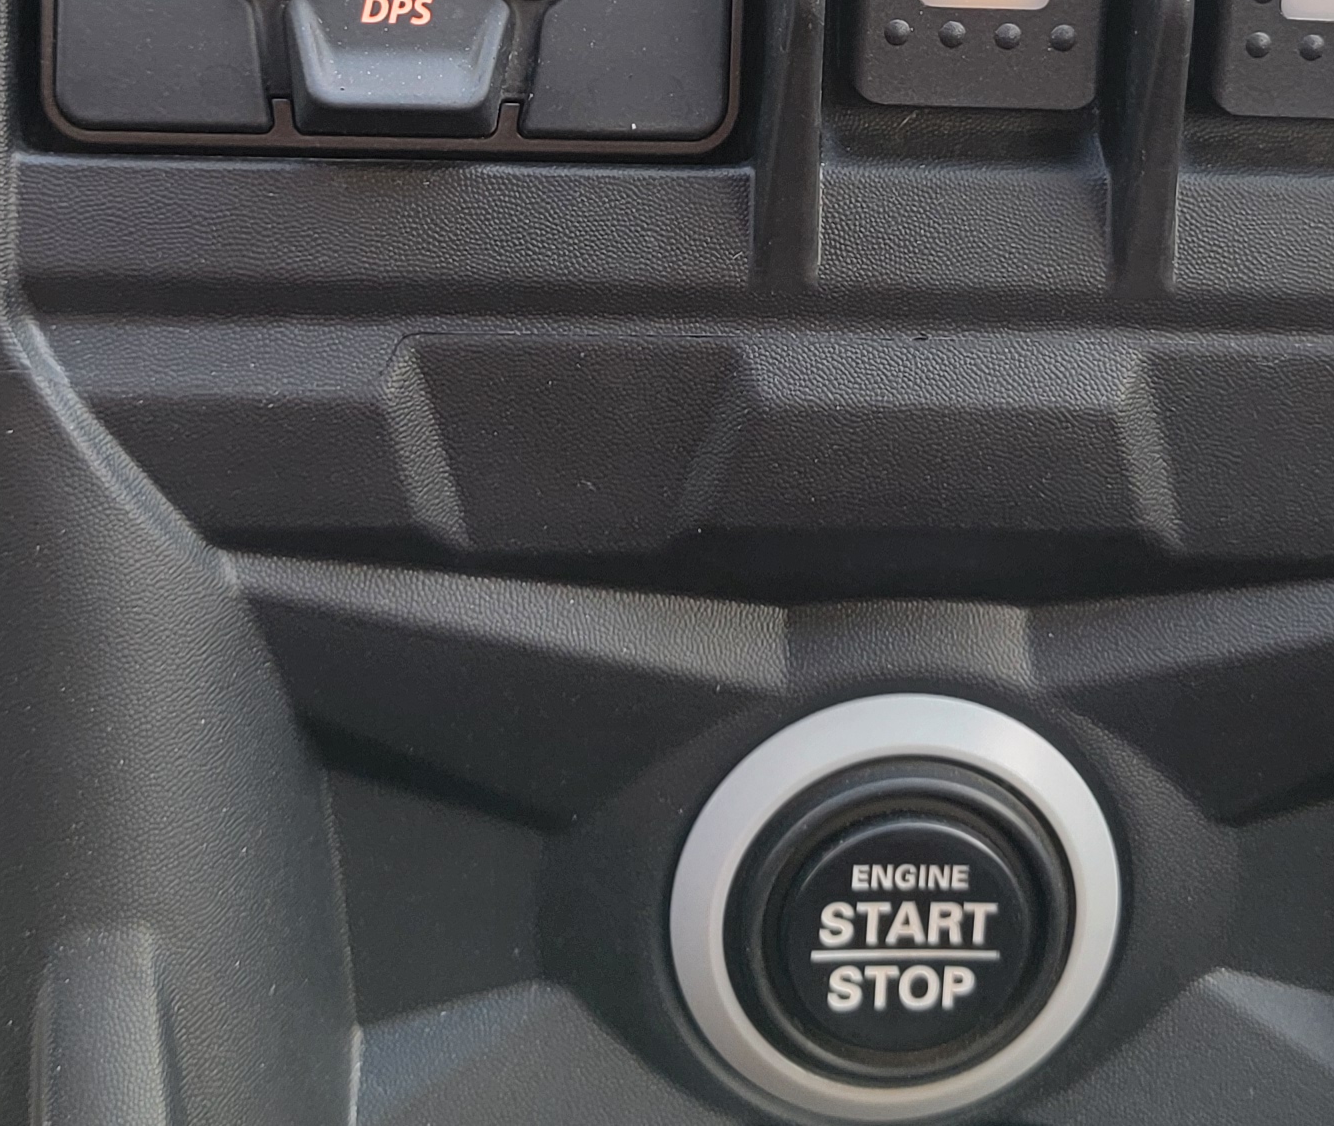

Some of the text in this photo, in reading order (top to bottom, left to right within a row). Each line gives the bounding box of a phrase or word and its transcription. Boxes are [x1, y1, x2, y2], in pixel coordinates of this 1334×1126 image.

[851, 864, 970, 891] ENGINE
[818, 901, 999, 947] START
[826, 965, 976, 1011] STOP
